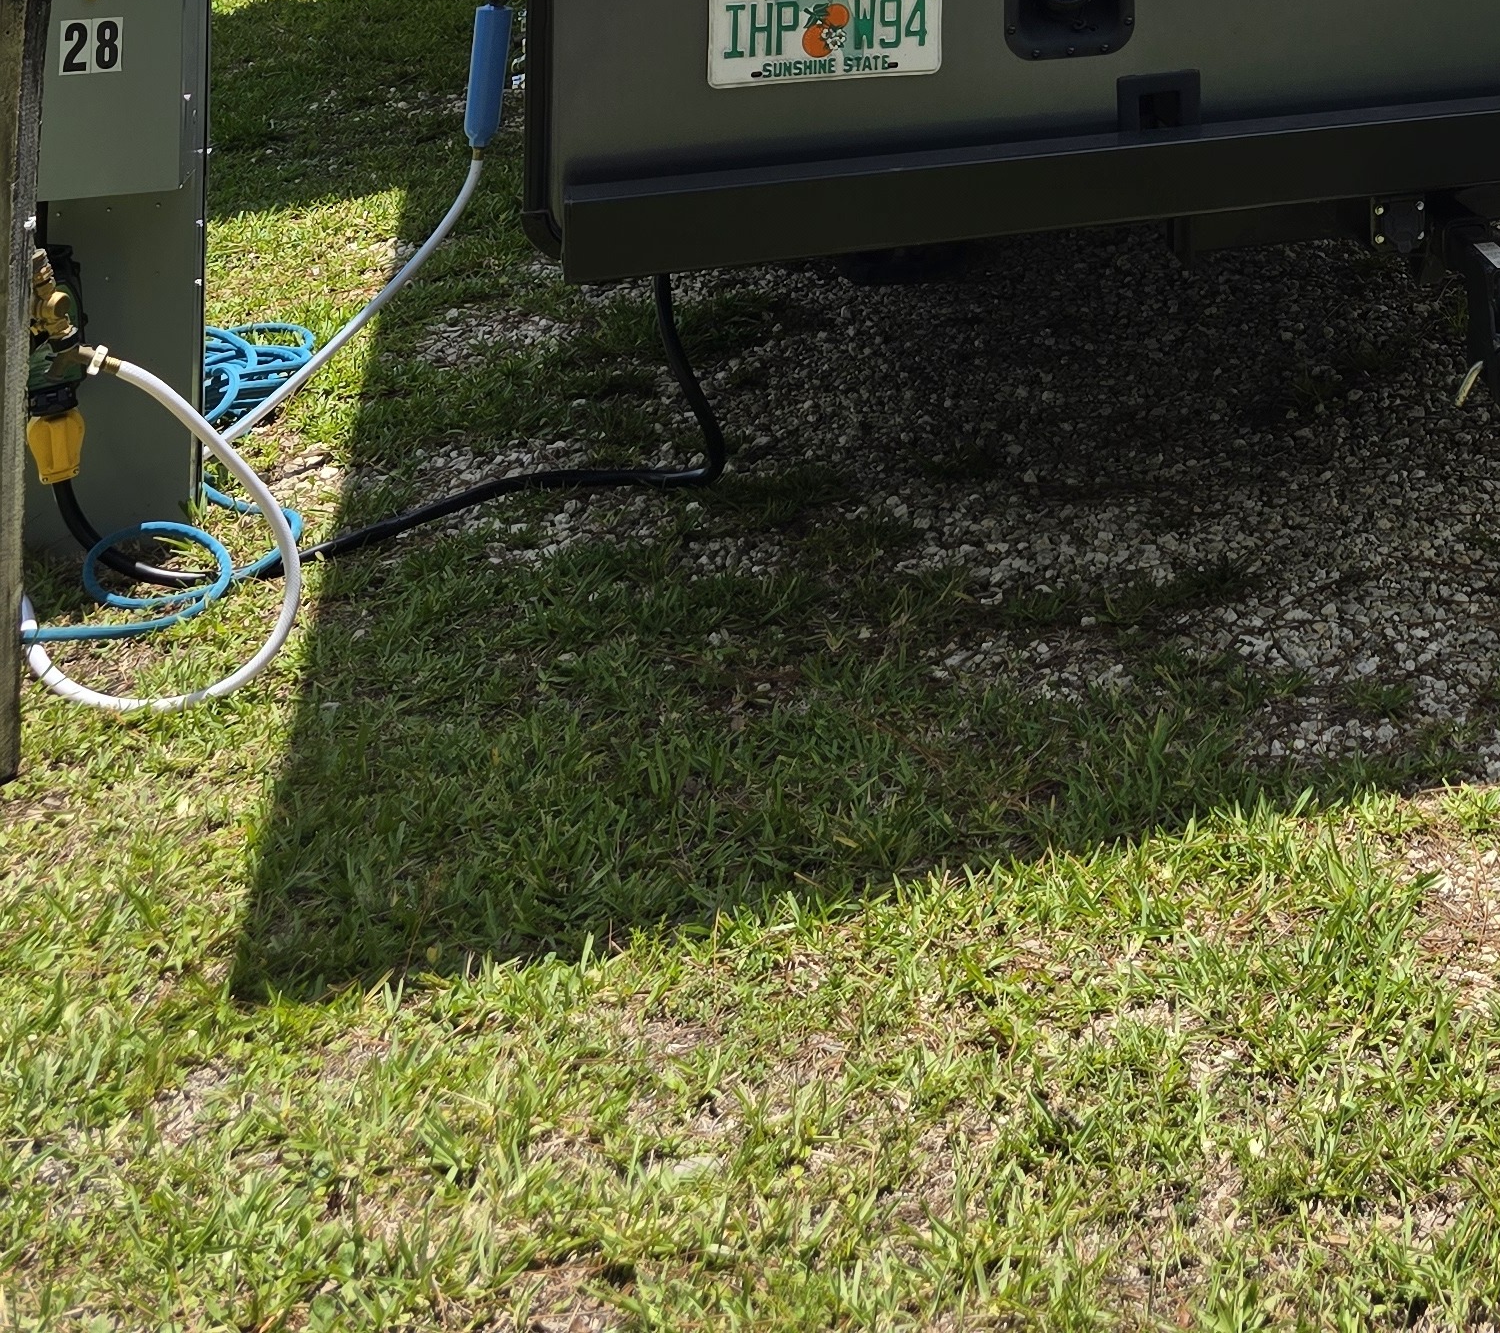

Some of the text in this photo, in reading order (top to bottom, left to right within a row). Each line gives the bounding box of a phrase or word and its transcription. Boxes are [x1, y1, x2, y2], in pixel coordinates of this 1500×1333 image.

[62, 20, 120, 73] 28
[723, 0, 800, 59] IHP
[761, 55, 891, 78] SUNSHINE STATE
